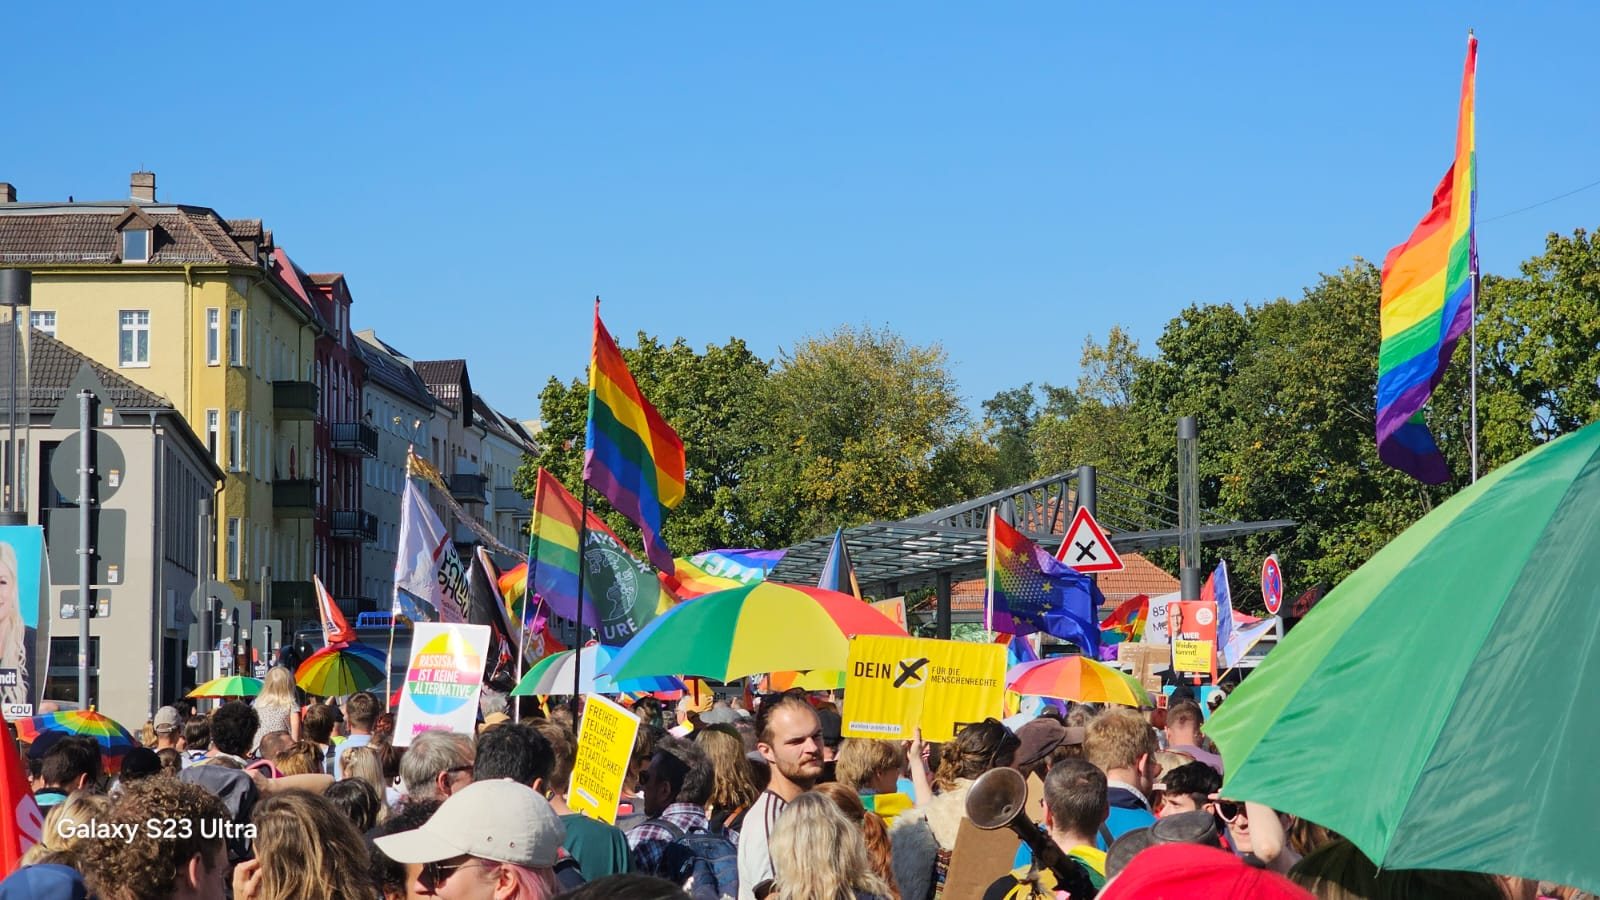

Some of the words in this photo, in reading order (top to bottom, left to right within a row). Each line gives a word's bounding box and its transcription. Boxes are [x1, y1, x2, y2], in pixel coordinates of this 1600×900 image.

[585, 531, 618, 549] AYS
[419, 655, 462, 669] RASSISM
[418, 670, 432, 682] IST
[433, 670, 459, 683] KEINE
[854, 661, 891, 679] DEIN
[931, 666, 947, 675] FÜR
[948, 667, 961, 676] DIE
[930, 675, 998, 687] MENSCHENRECHTE
[414, 682, 472, 697] ALTERNATIVE
[10, 705, 32, 714] CDU
[577, 757, 591, 772] FÜR
[591, 768, 606, 783] ALLE
